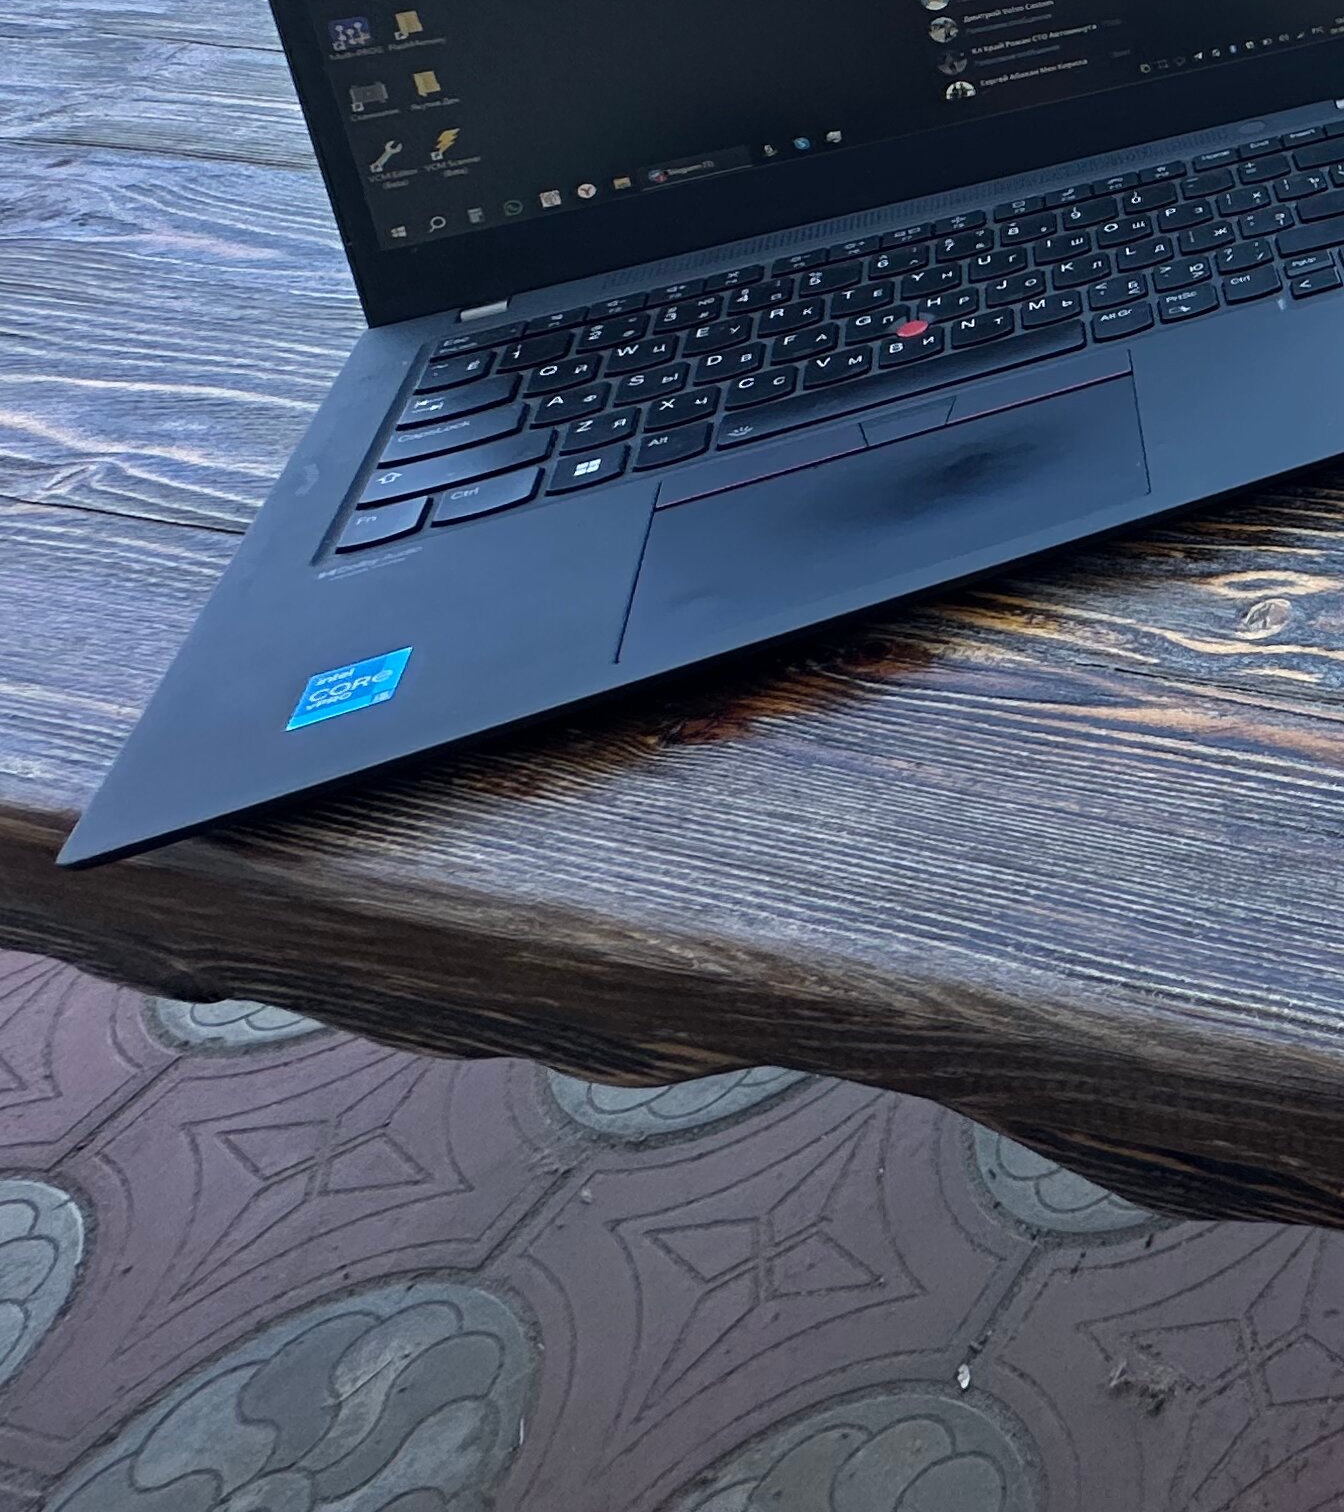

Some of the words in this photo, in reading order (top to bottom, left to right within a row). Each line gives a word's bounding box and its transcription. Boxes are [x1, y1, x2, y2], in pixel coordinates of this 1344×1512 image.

[355, 514, 377, 525] Fn
[450, 487, 480, 501] Ctrl
[648, 436, 669, 447] Alt
[1230, 275, 1251, 285] Ctrl
[317, 667, 356, 686] intel
